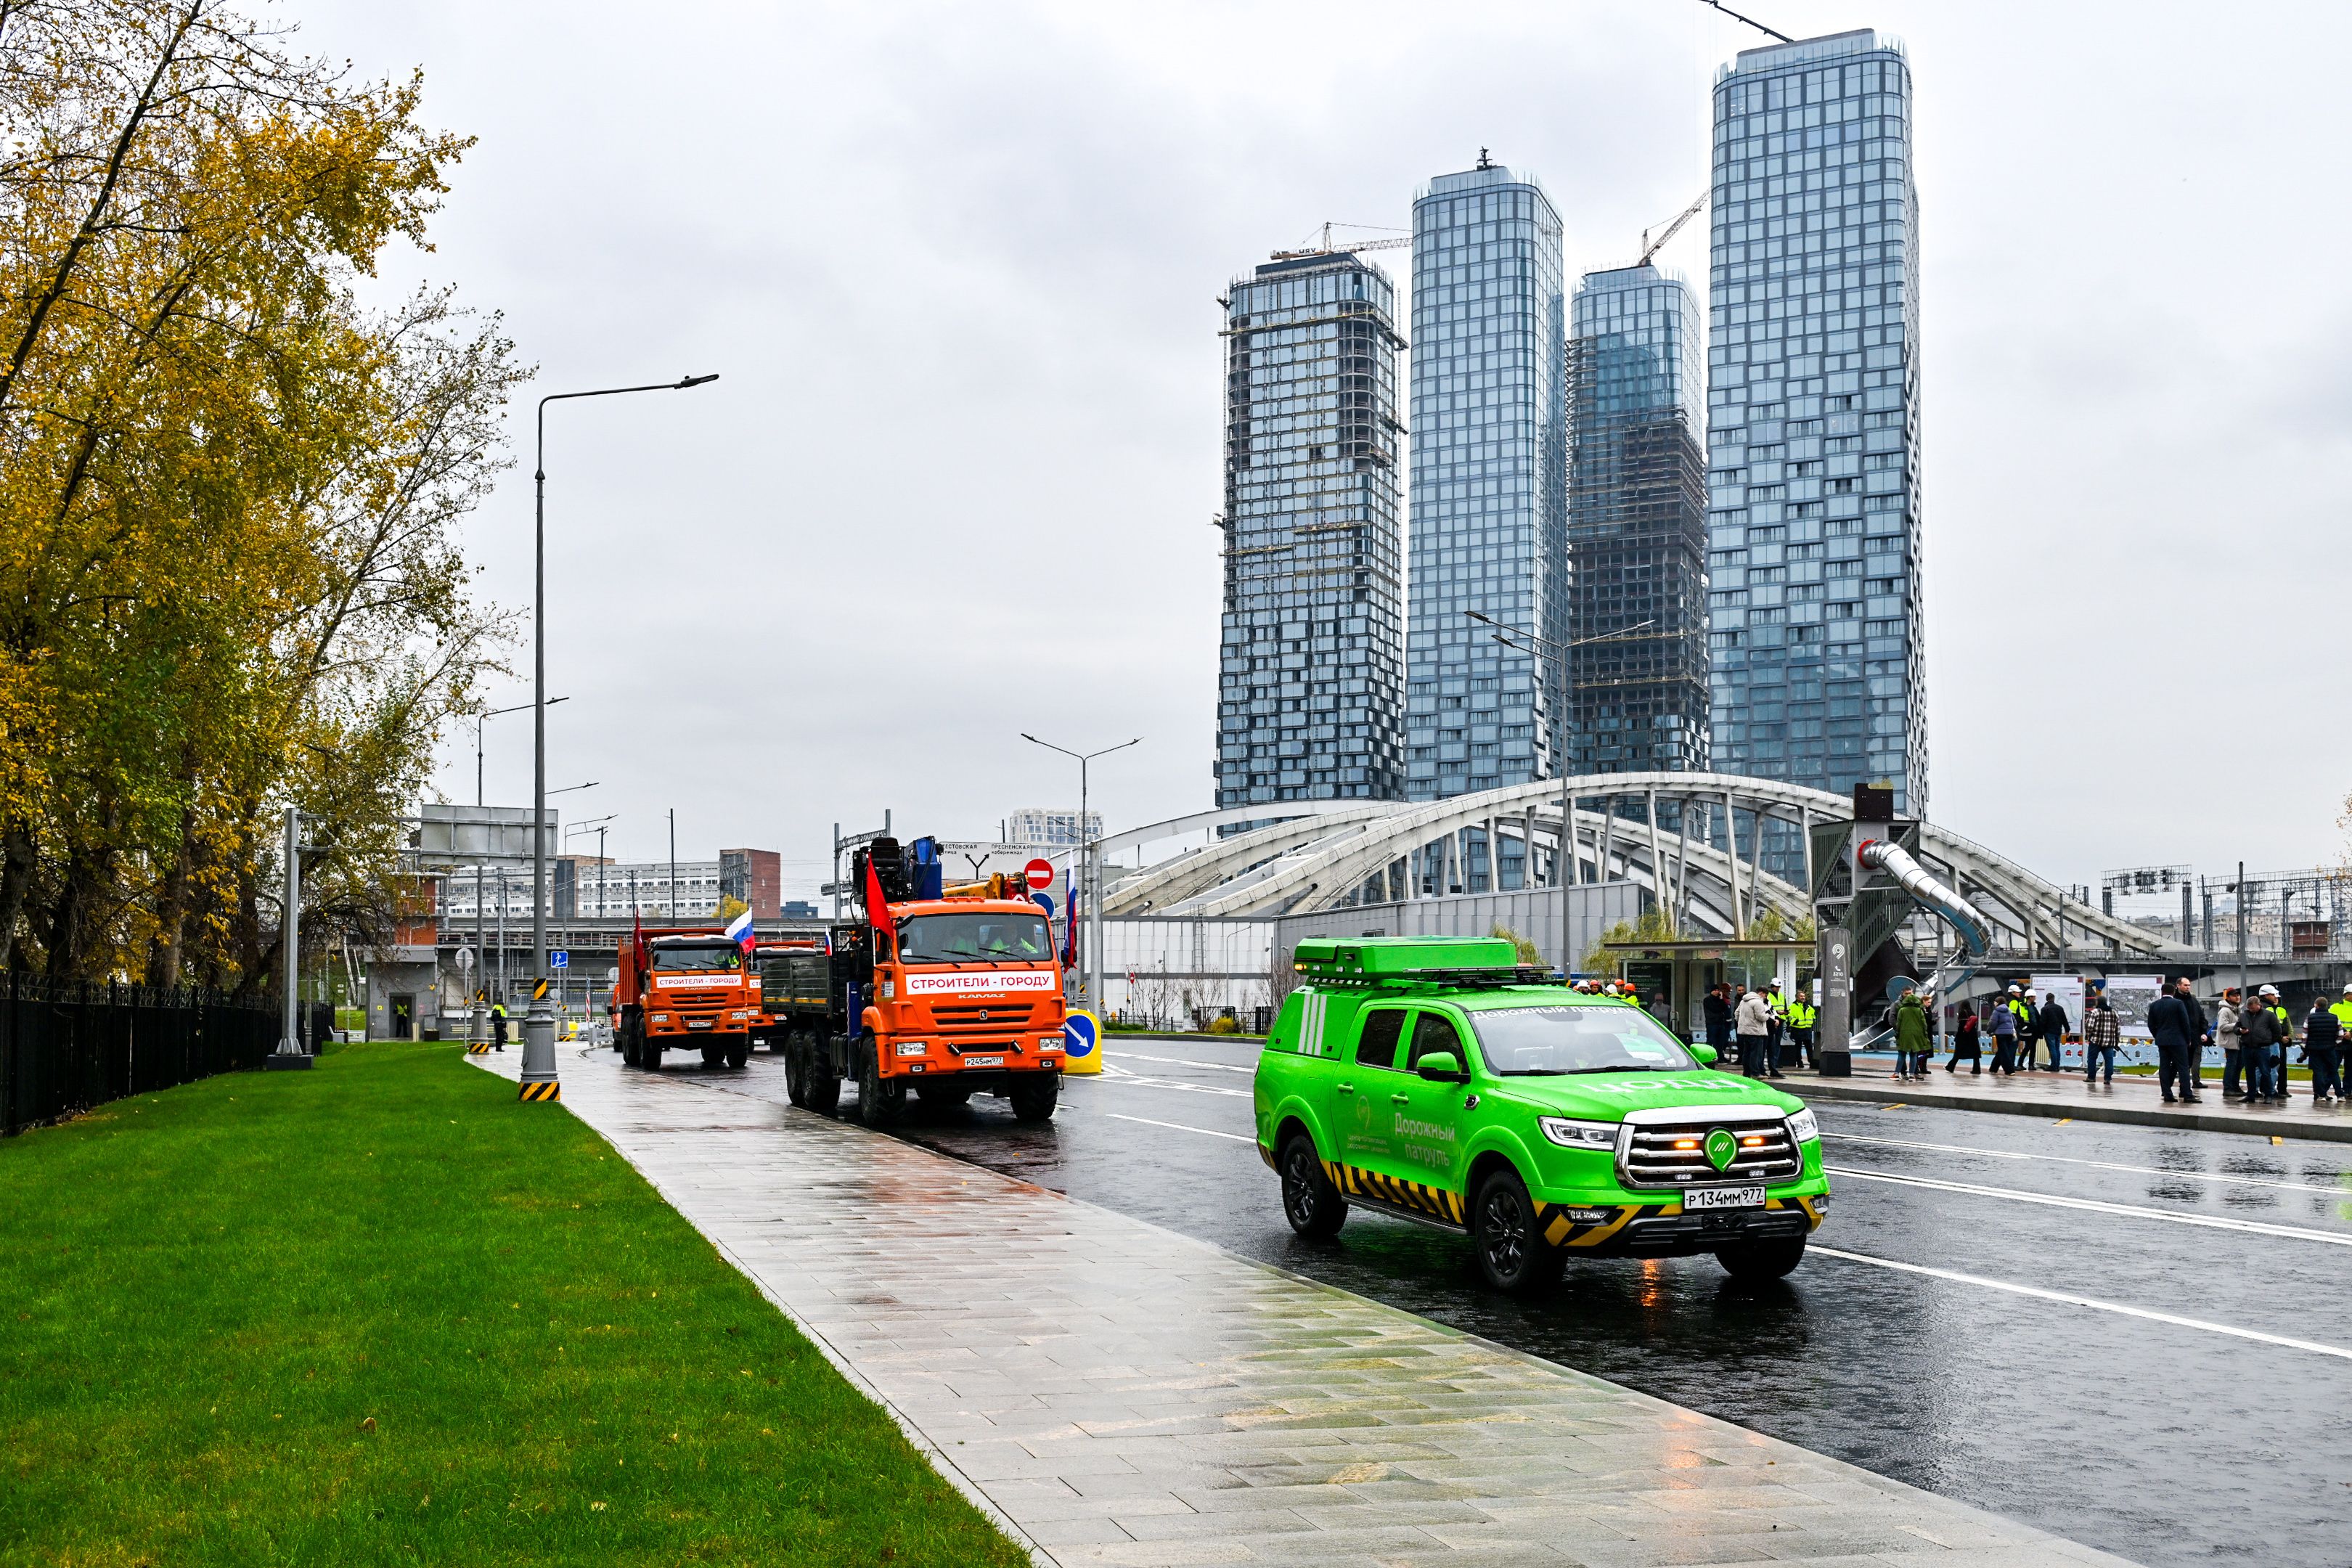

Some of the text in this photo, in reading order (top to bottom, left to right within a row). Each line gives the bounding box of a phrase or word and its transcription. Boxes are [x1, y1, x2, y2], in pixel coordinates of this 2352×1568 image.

[911, 977, 989, 989] СТРОИТЕЛИ
[1001, 976, 1050, 987] ГОРОДУ
[1472, 1005, 1639, 1021] Дорожный патруль
[1395, 1112, 1455, 1142] Дорожный
[1405, 1143, 1450, 1168] патруль
